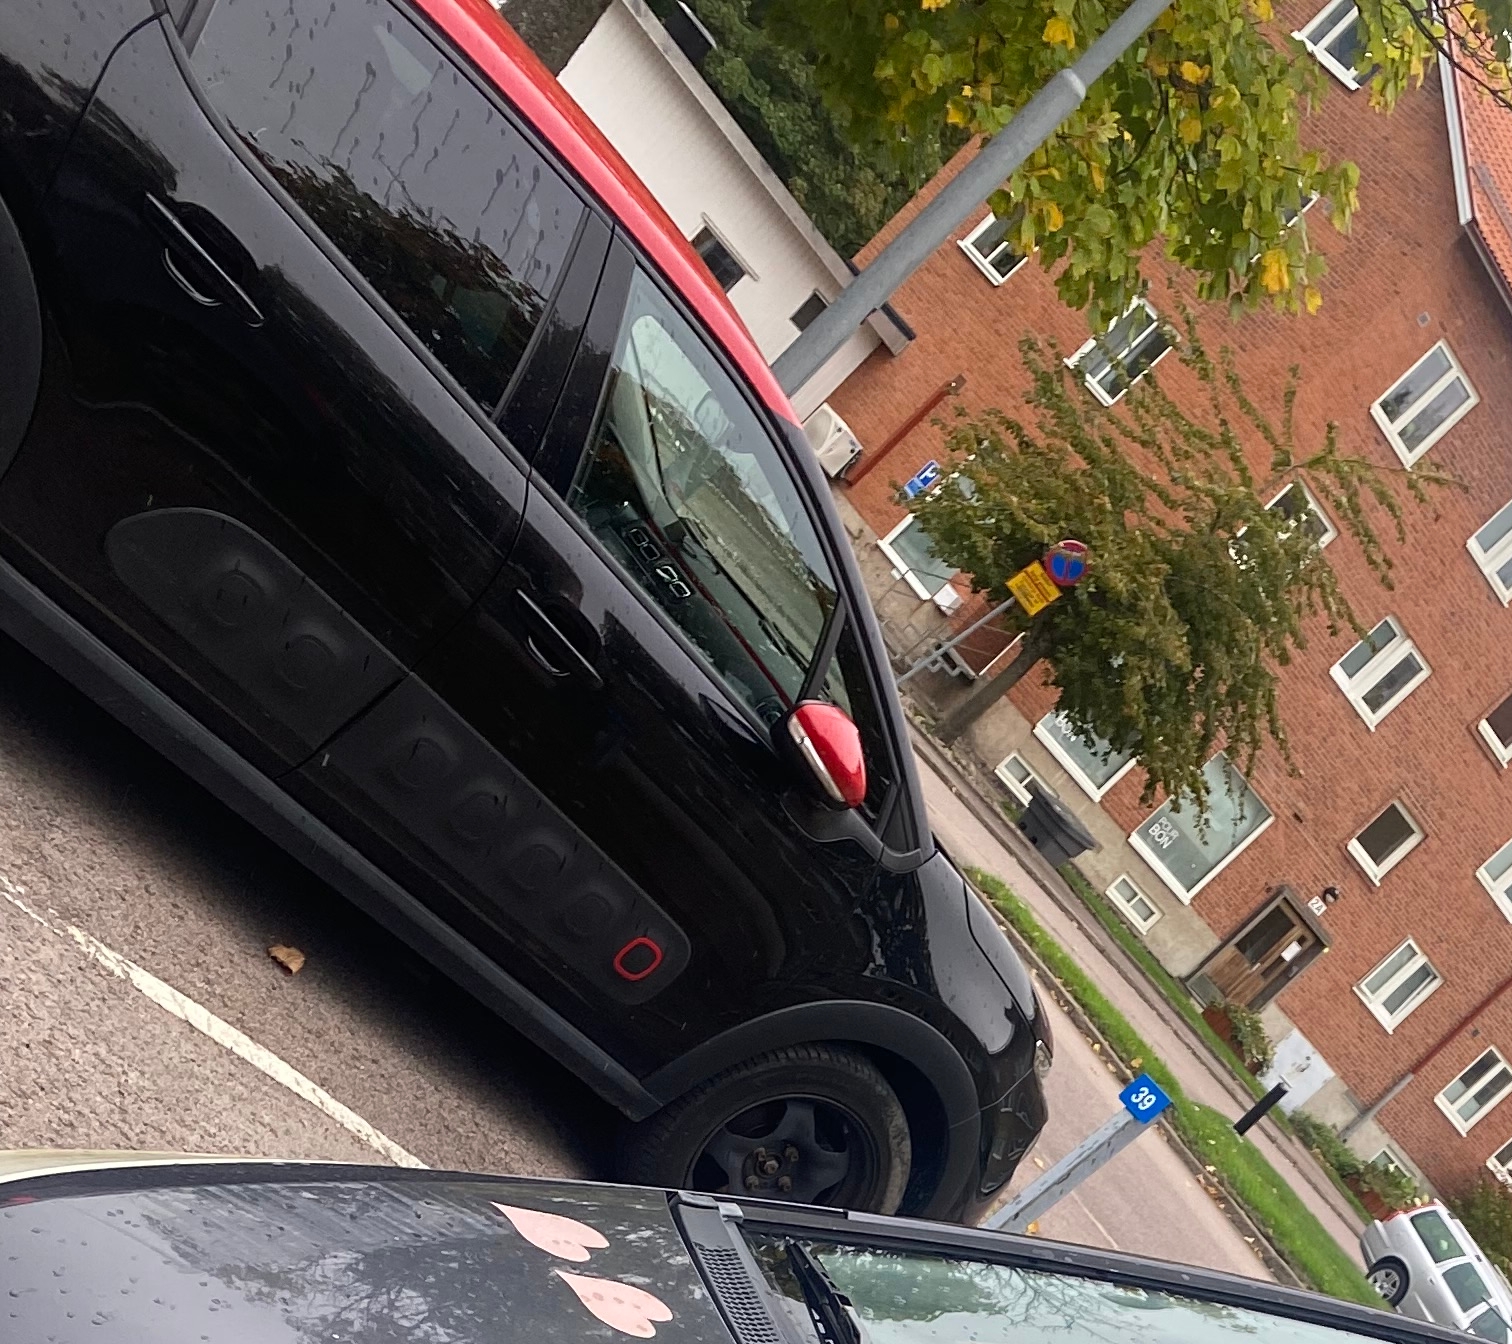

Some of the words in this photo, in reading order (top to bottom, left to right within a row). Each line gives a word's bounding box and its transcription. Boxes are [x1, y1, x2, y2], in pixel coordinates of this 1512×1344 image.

[1148, 823, 1173, 849] BON
[1158, 816, 1180, 841] POUR
[1310, 898, 1324, 914] 2A
[1131, 1087, 1156, 1111] 39
